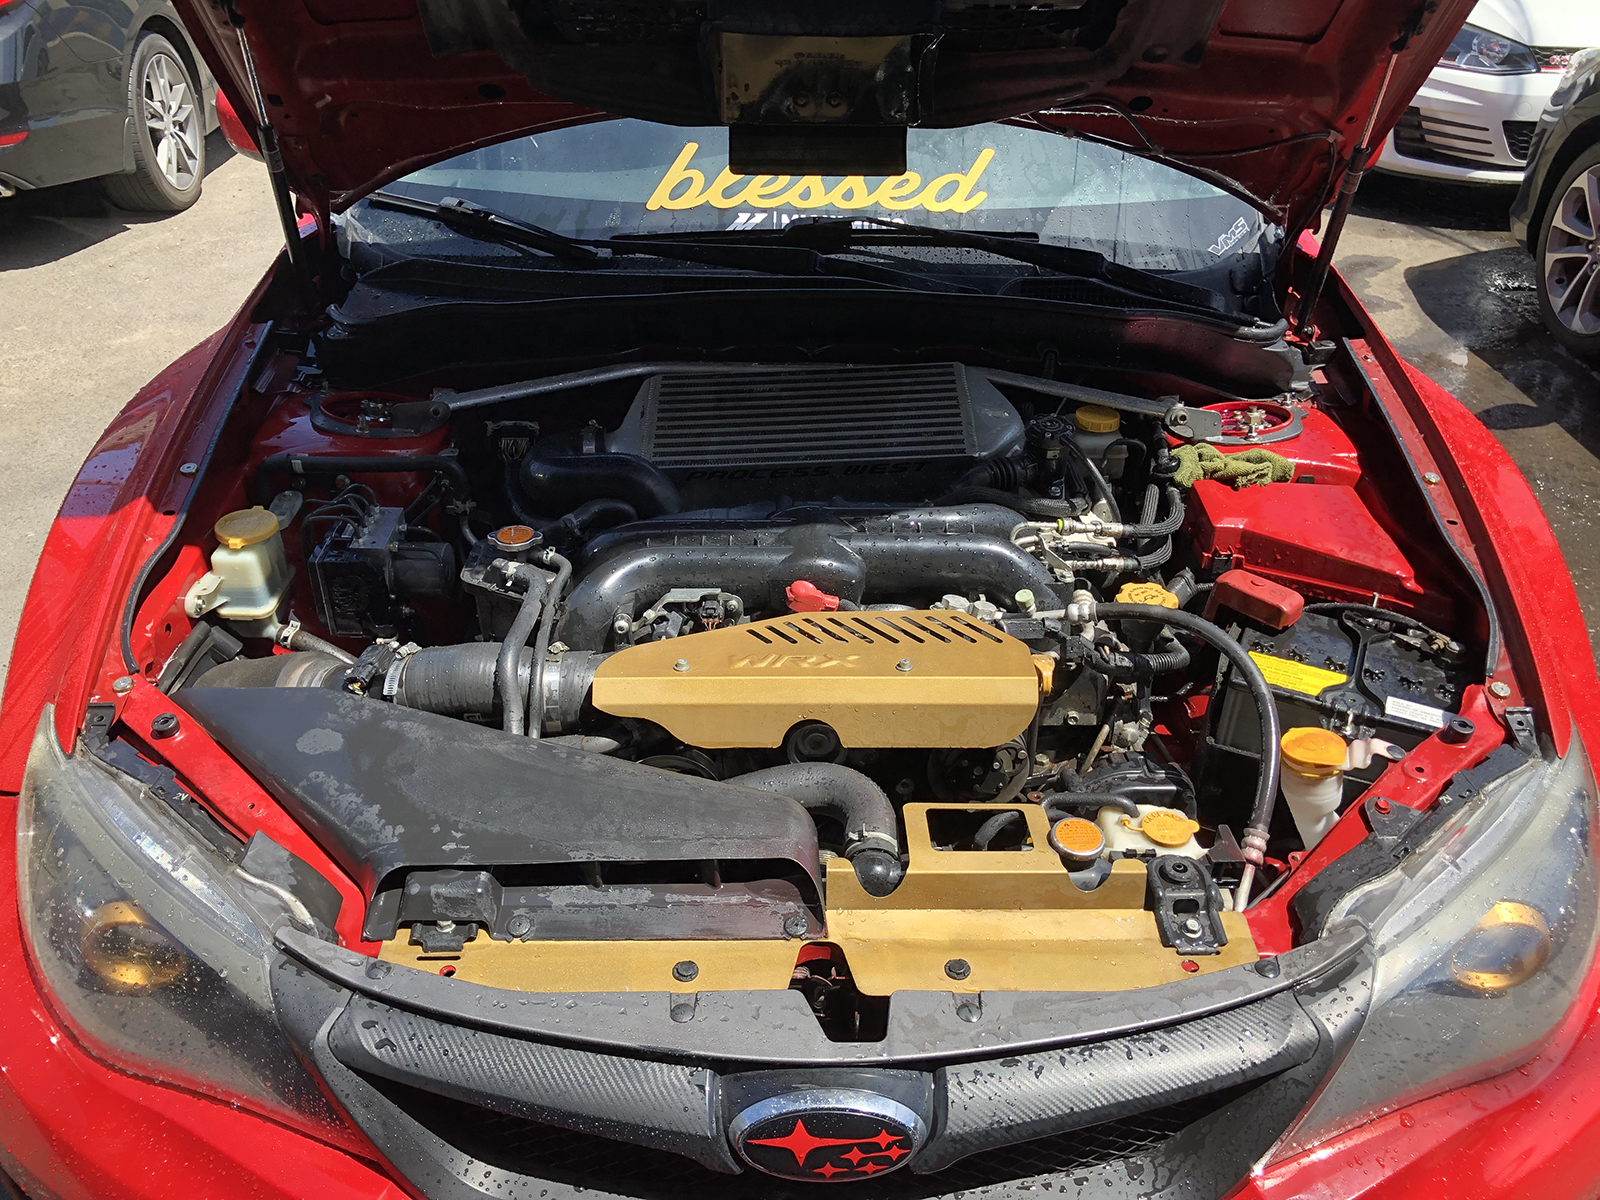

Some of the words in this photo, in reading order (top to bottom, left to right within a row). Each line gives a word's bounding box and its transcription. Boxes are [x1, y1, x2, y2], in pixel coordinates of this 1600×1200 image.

[645, 142, 996, 213] blessed
[1207, 216, 1248, 256] VMS
[686, 465, 833, 482] PROCESS
[842, 461, 933, 476] WEST
[727, 653, 861, 669] WRX
